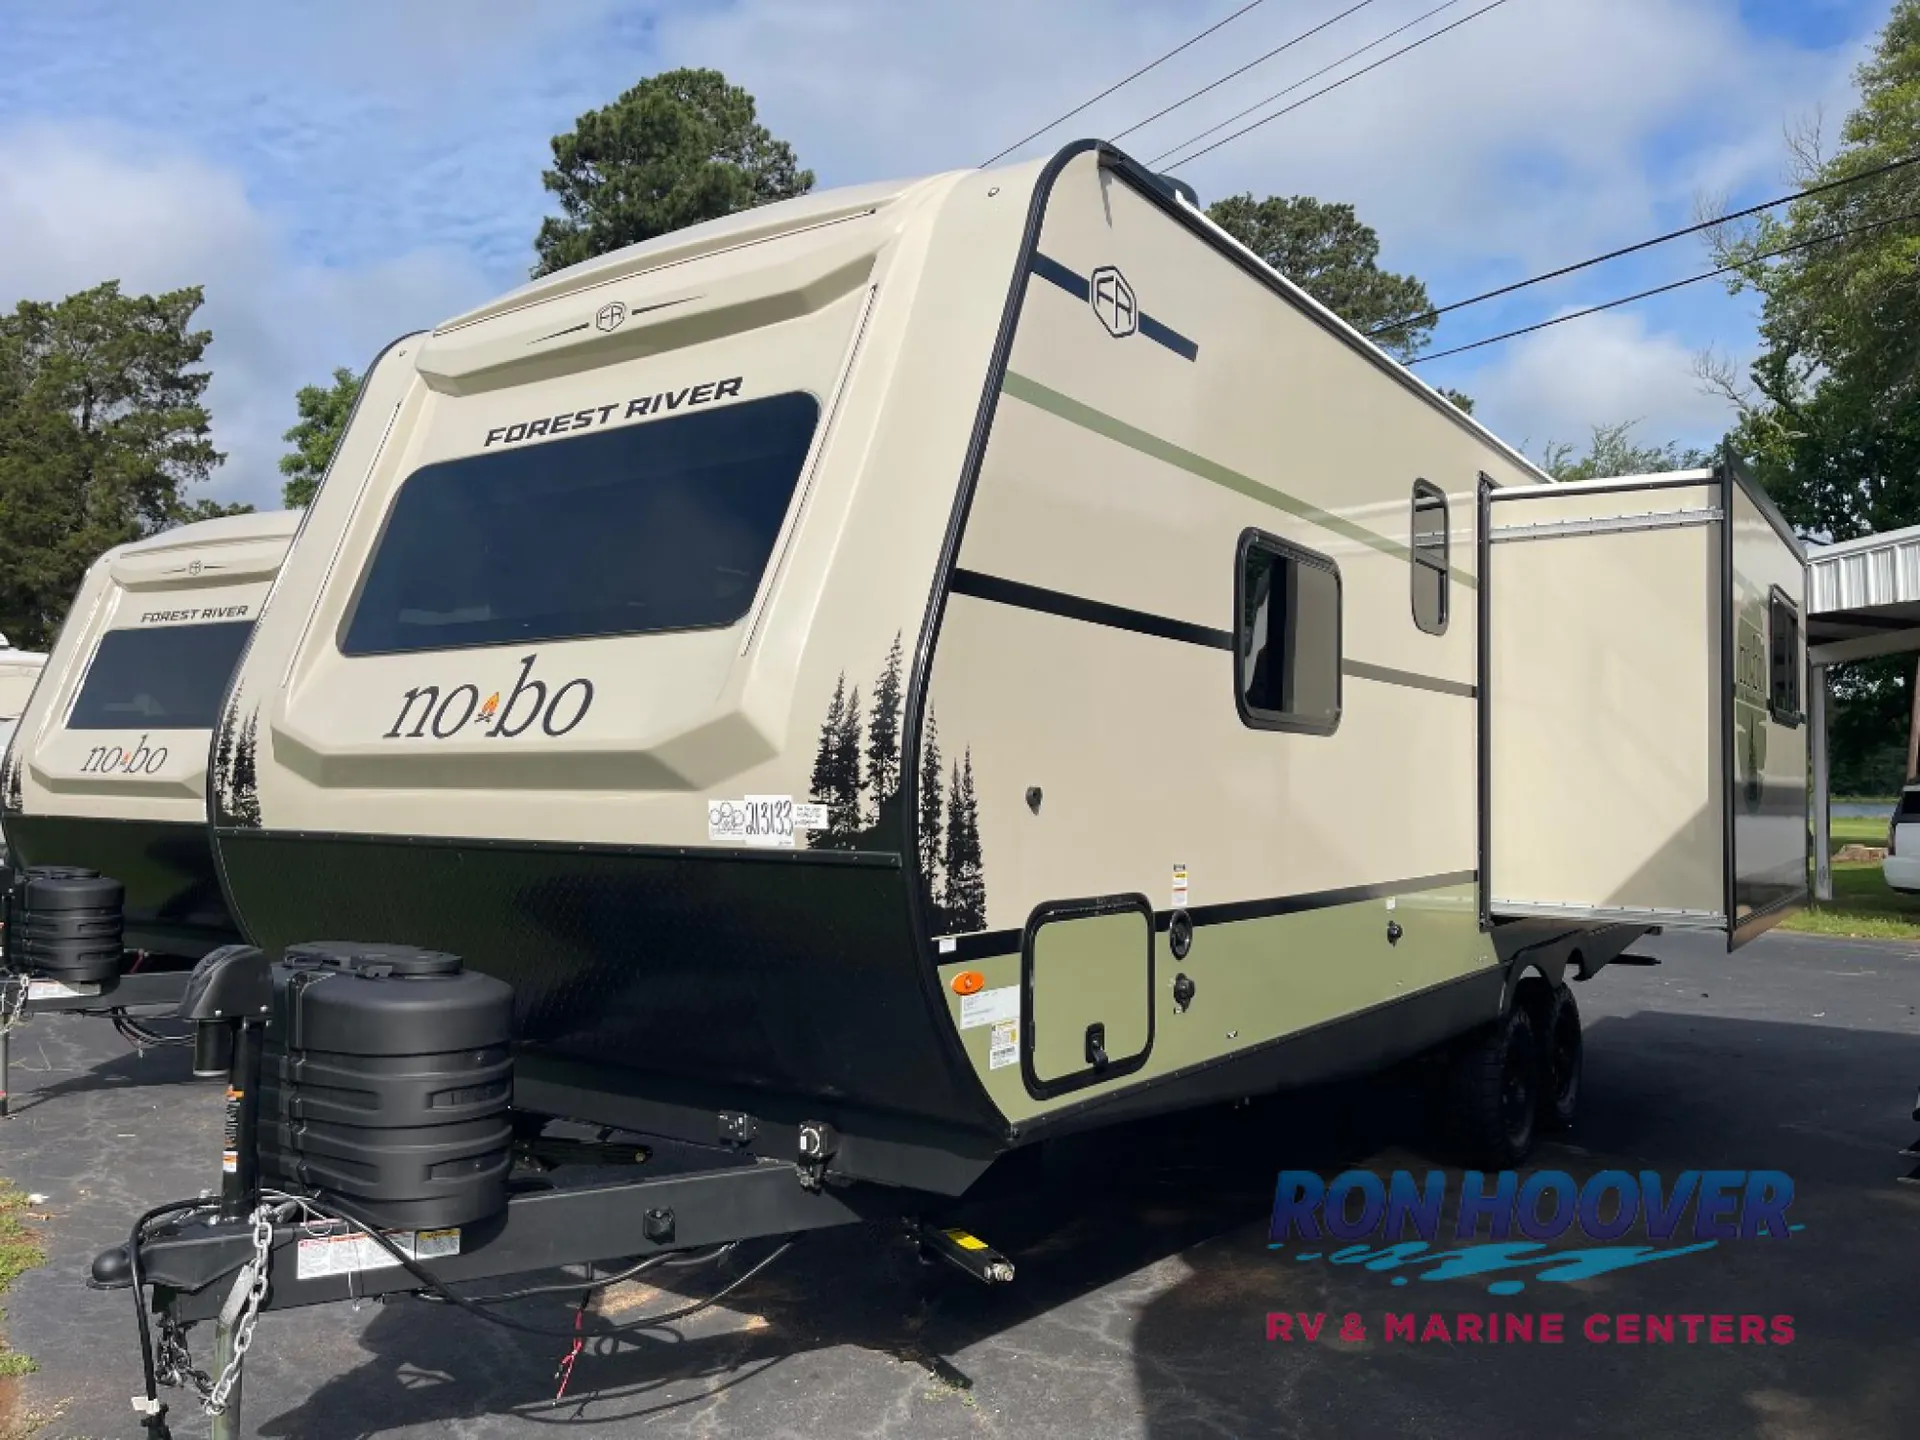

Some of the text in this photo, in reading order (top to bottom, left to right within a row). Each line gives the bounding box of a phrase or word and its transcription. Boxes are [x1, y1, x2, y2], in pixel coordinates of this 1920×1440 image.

[484, 376, 743, 447] FOREST RIVER
[140, 605, 249, 623] FOREST RIVER
